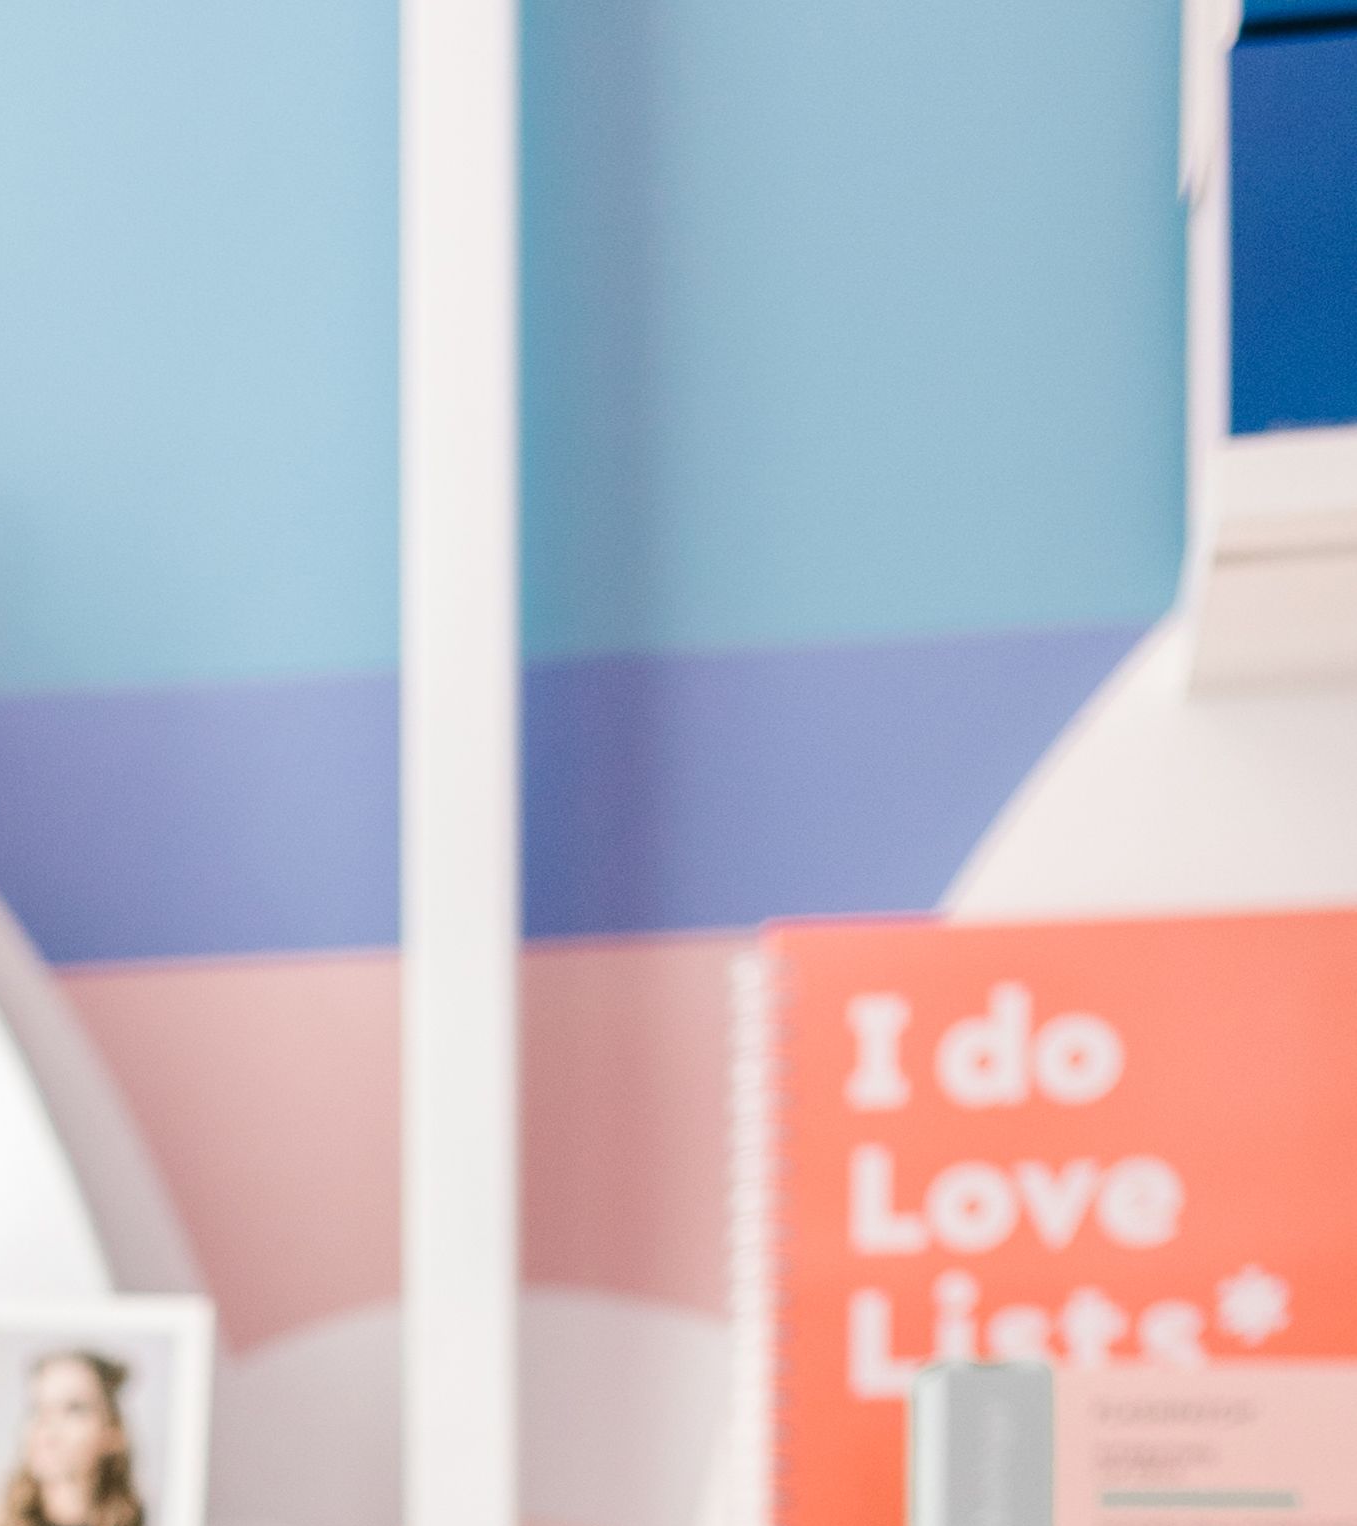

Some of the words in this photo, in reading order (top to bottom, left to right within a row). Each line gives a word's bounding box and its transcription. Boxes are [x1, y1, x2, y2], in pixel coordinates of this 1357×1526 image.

[846, 992, 911, 1110] I
[936, 981, 1124, 1107] do
[849, 1143, 1184, 1255] Love
